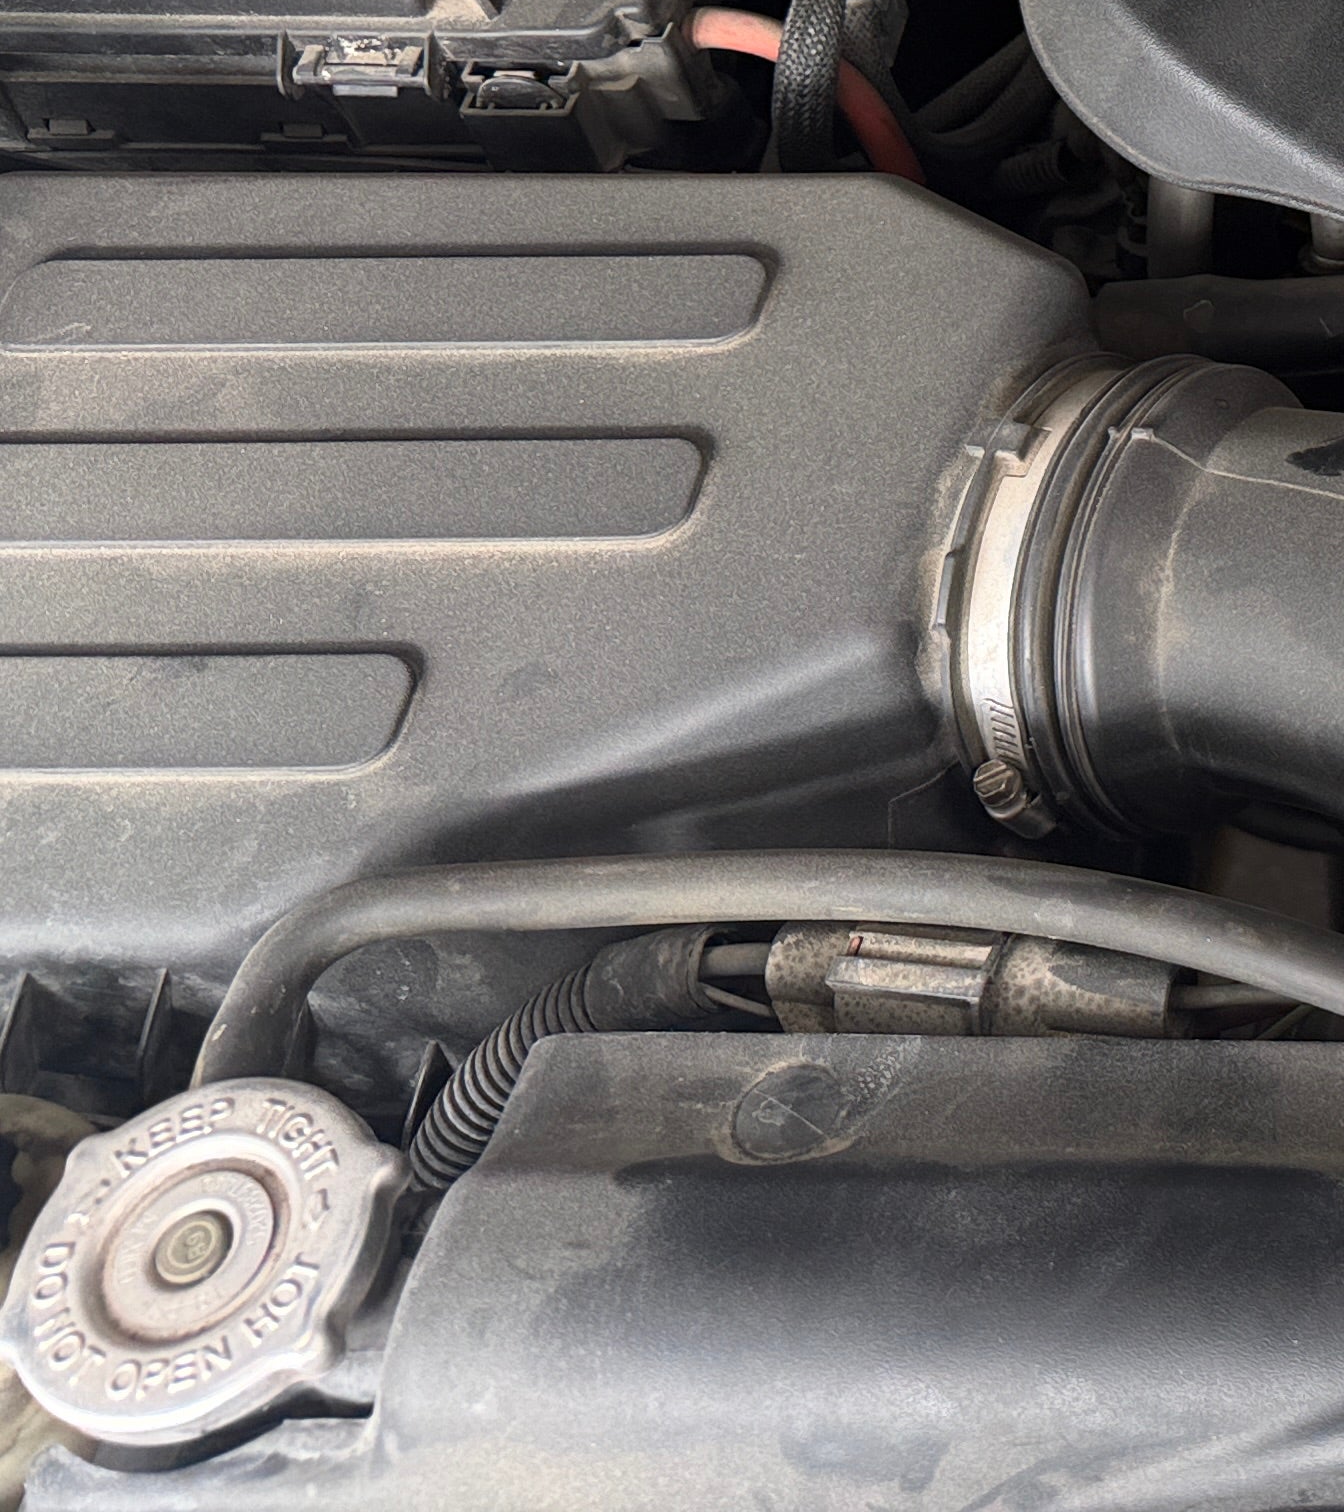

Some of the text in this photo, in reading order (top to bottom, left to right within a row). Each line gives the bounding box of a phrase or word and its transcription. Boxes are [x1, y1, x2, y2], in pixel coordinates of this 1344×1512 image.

[115, 1096, 340, 1180] KEEP TIGHT
[34, 1306, 106, 1386] NOT
[105, 1335, 233, 1401] OPEN
[242, 1251, 321, 1348] HOT
